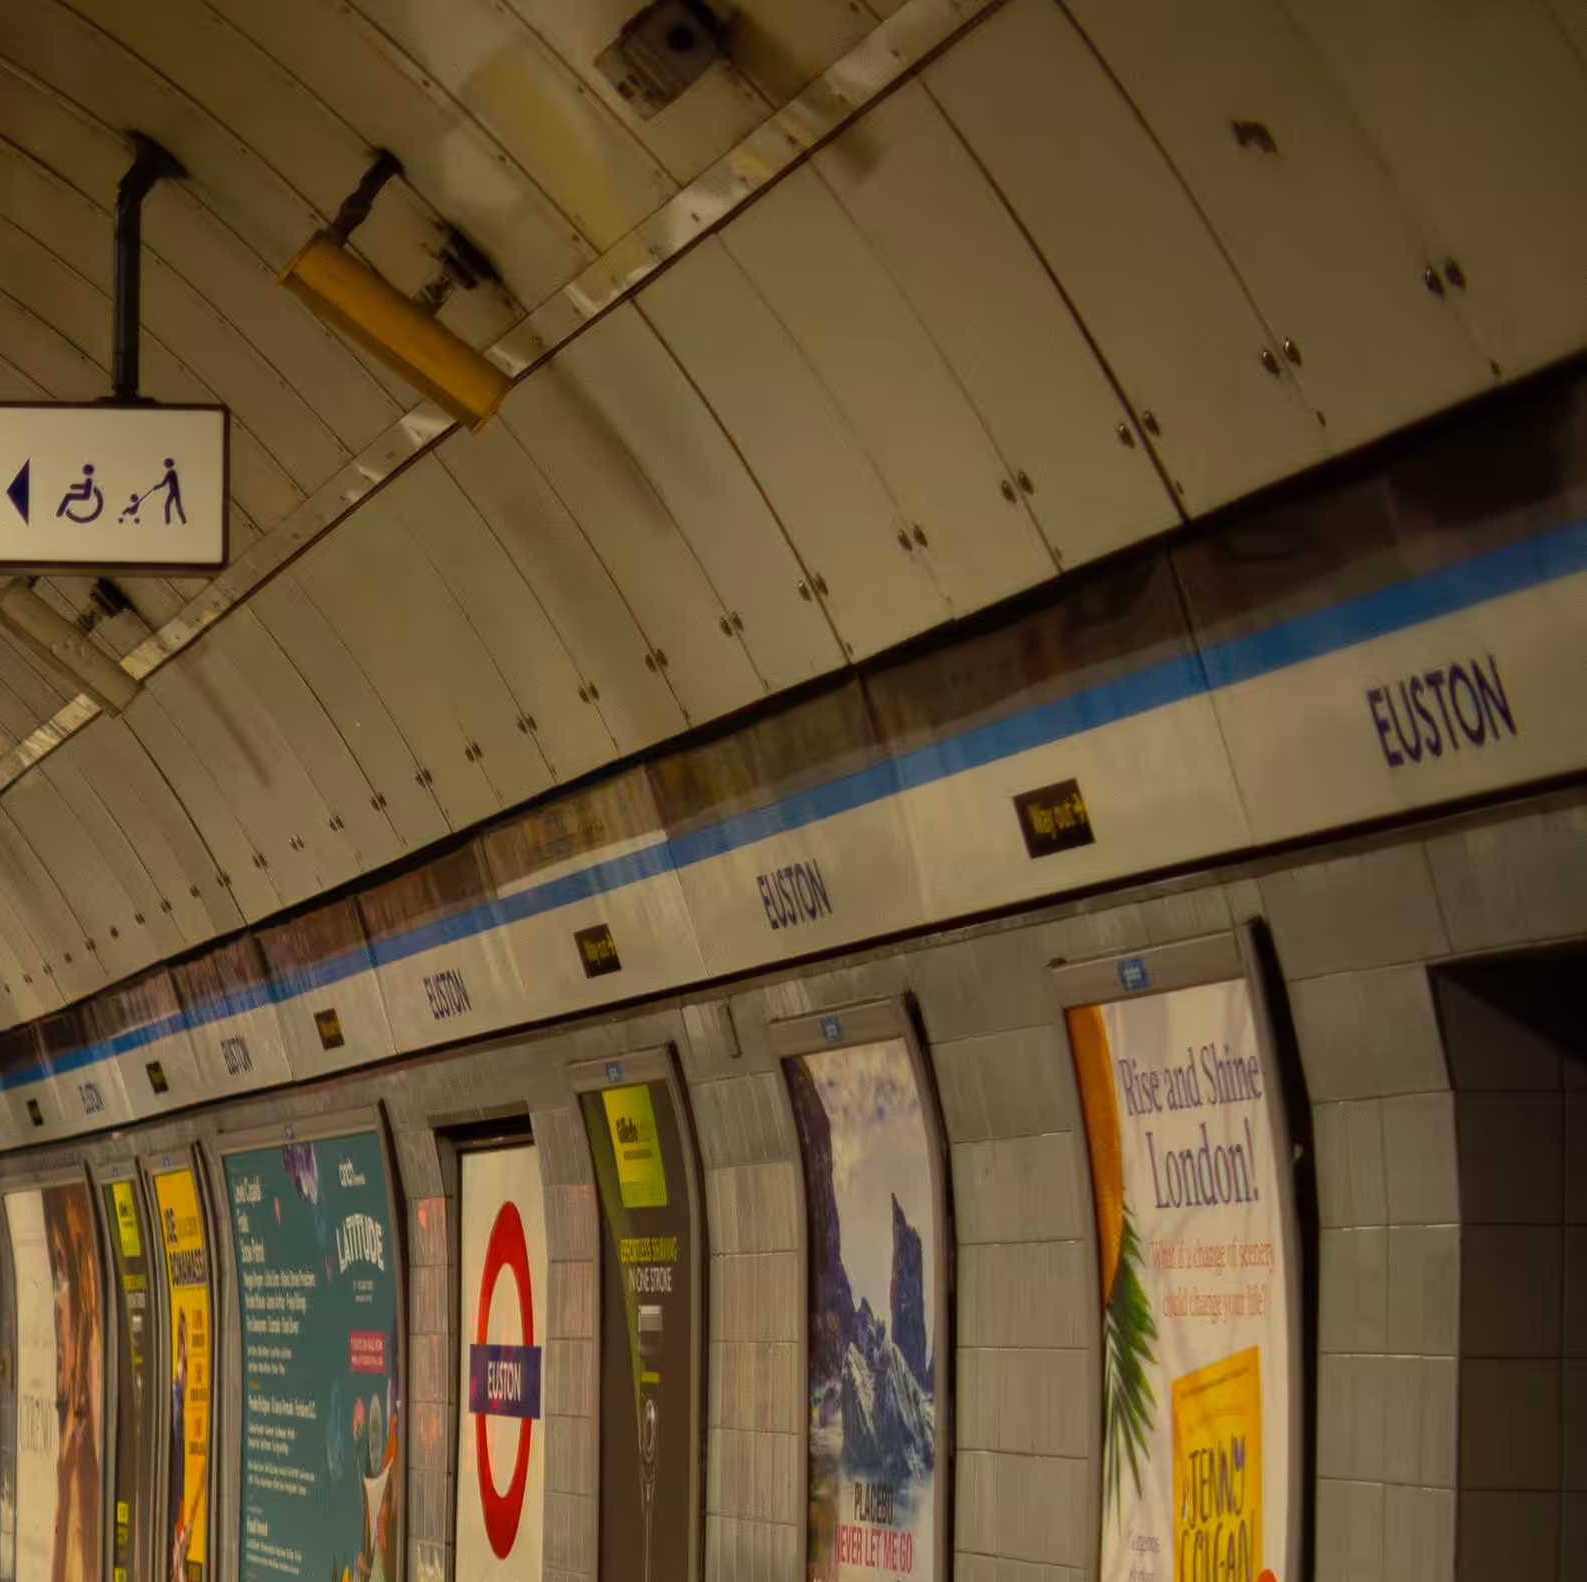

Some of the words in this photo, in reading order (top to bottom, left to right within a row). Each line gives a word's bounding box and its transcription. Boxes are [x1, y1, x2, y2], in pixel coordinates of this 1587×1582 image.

[1366, 655, 1517, 768] EUSTON
[1027, 802, 1055, 841] Way
[1054, 799, 1075, 830] out
[756, 859, 833, 930] EUSTON
[423, 968, 473, 1020] EUSTON
[1119, 1058, 1163, 1116] Rise
[1165, 1047, 1202, 1110] and
[1200, 1042, 1262, 1105] Shine
[1145, 1117, 1259, 1209] London!
[336, 1212, 385, 1274] LATITUDE
[1150, 1240, 1176, 1270] What
[637, 1268, 649, 1291] ONE
[650, 1267, 673, 1292] STROKE
[486, 1360, 523, 1402] EUSTON
[854, 1482, 894, 1525] PLACEBO
[1188, 1433, 1246, 1529] JENNY
[834, 1522, 862, 1566] NEVER
[865, 1527, 881, 1569] LET
[883, 1529, 898, 1572] ME
[899, 1531, 913, 1574] GO
